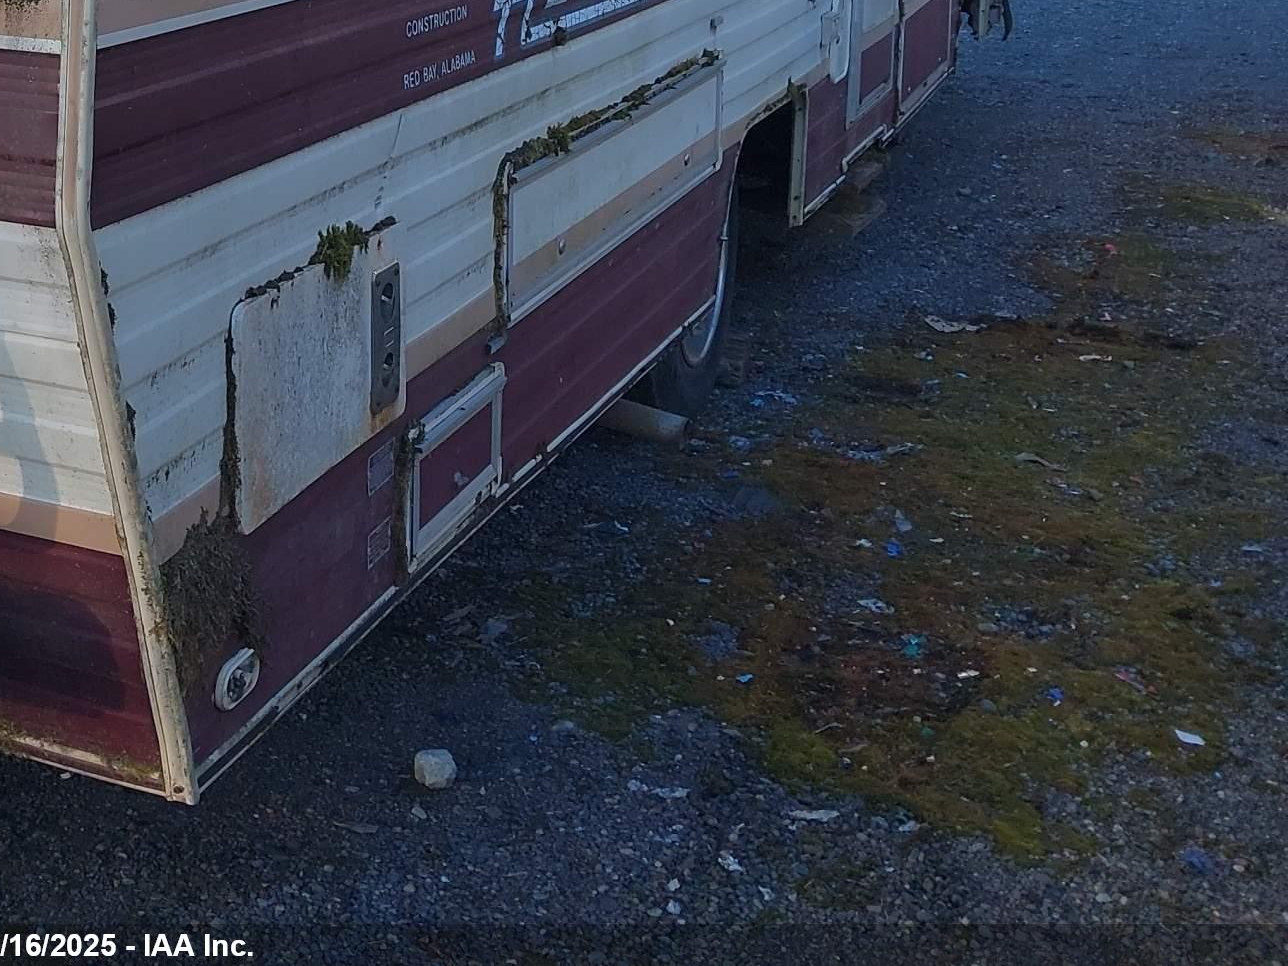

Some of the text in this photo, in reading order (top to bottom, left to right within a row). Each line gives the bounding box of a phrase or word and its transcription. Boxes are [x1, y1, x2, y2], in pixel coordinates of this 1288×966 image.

[406, 4, 468, 38] CONSTRUCTION
[403, 49, 476, 90] RED BAY, ALABAMA
